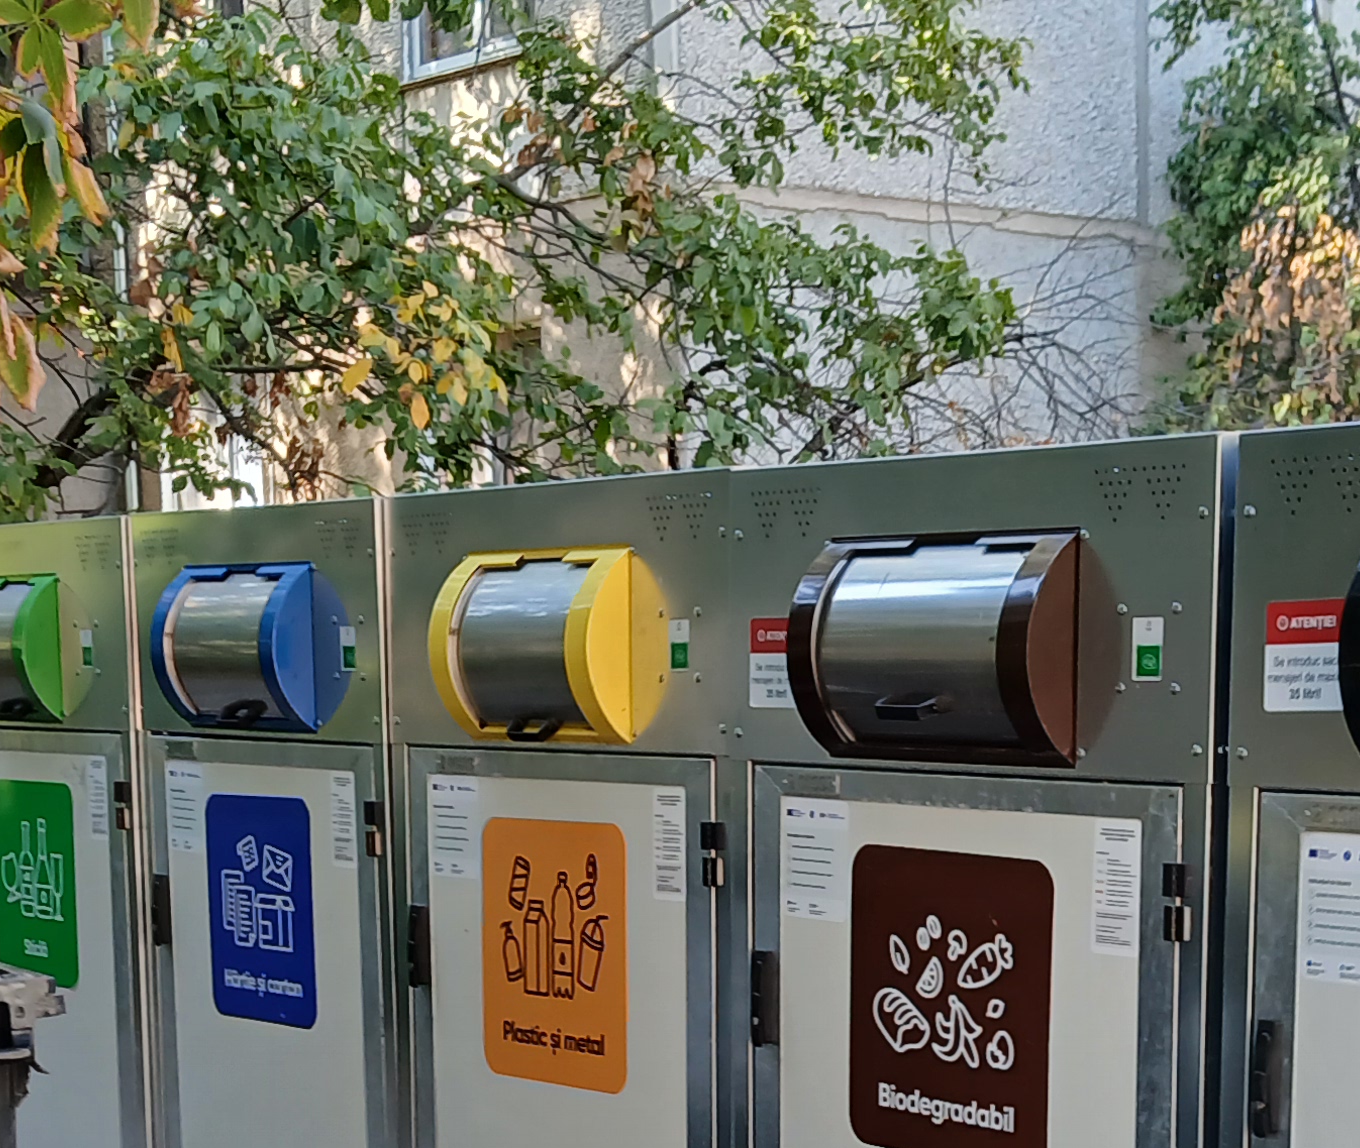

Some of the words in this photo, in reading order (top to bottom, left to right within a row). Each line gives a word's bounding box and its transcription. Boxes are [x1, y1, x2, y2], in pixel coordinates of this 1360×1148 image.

[503, 1020, 549, 1048] Plastic
[563, 1033, 606, 1057] metal
[877, 1081, 1016, 1134] Biodegradabil
